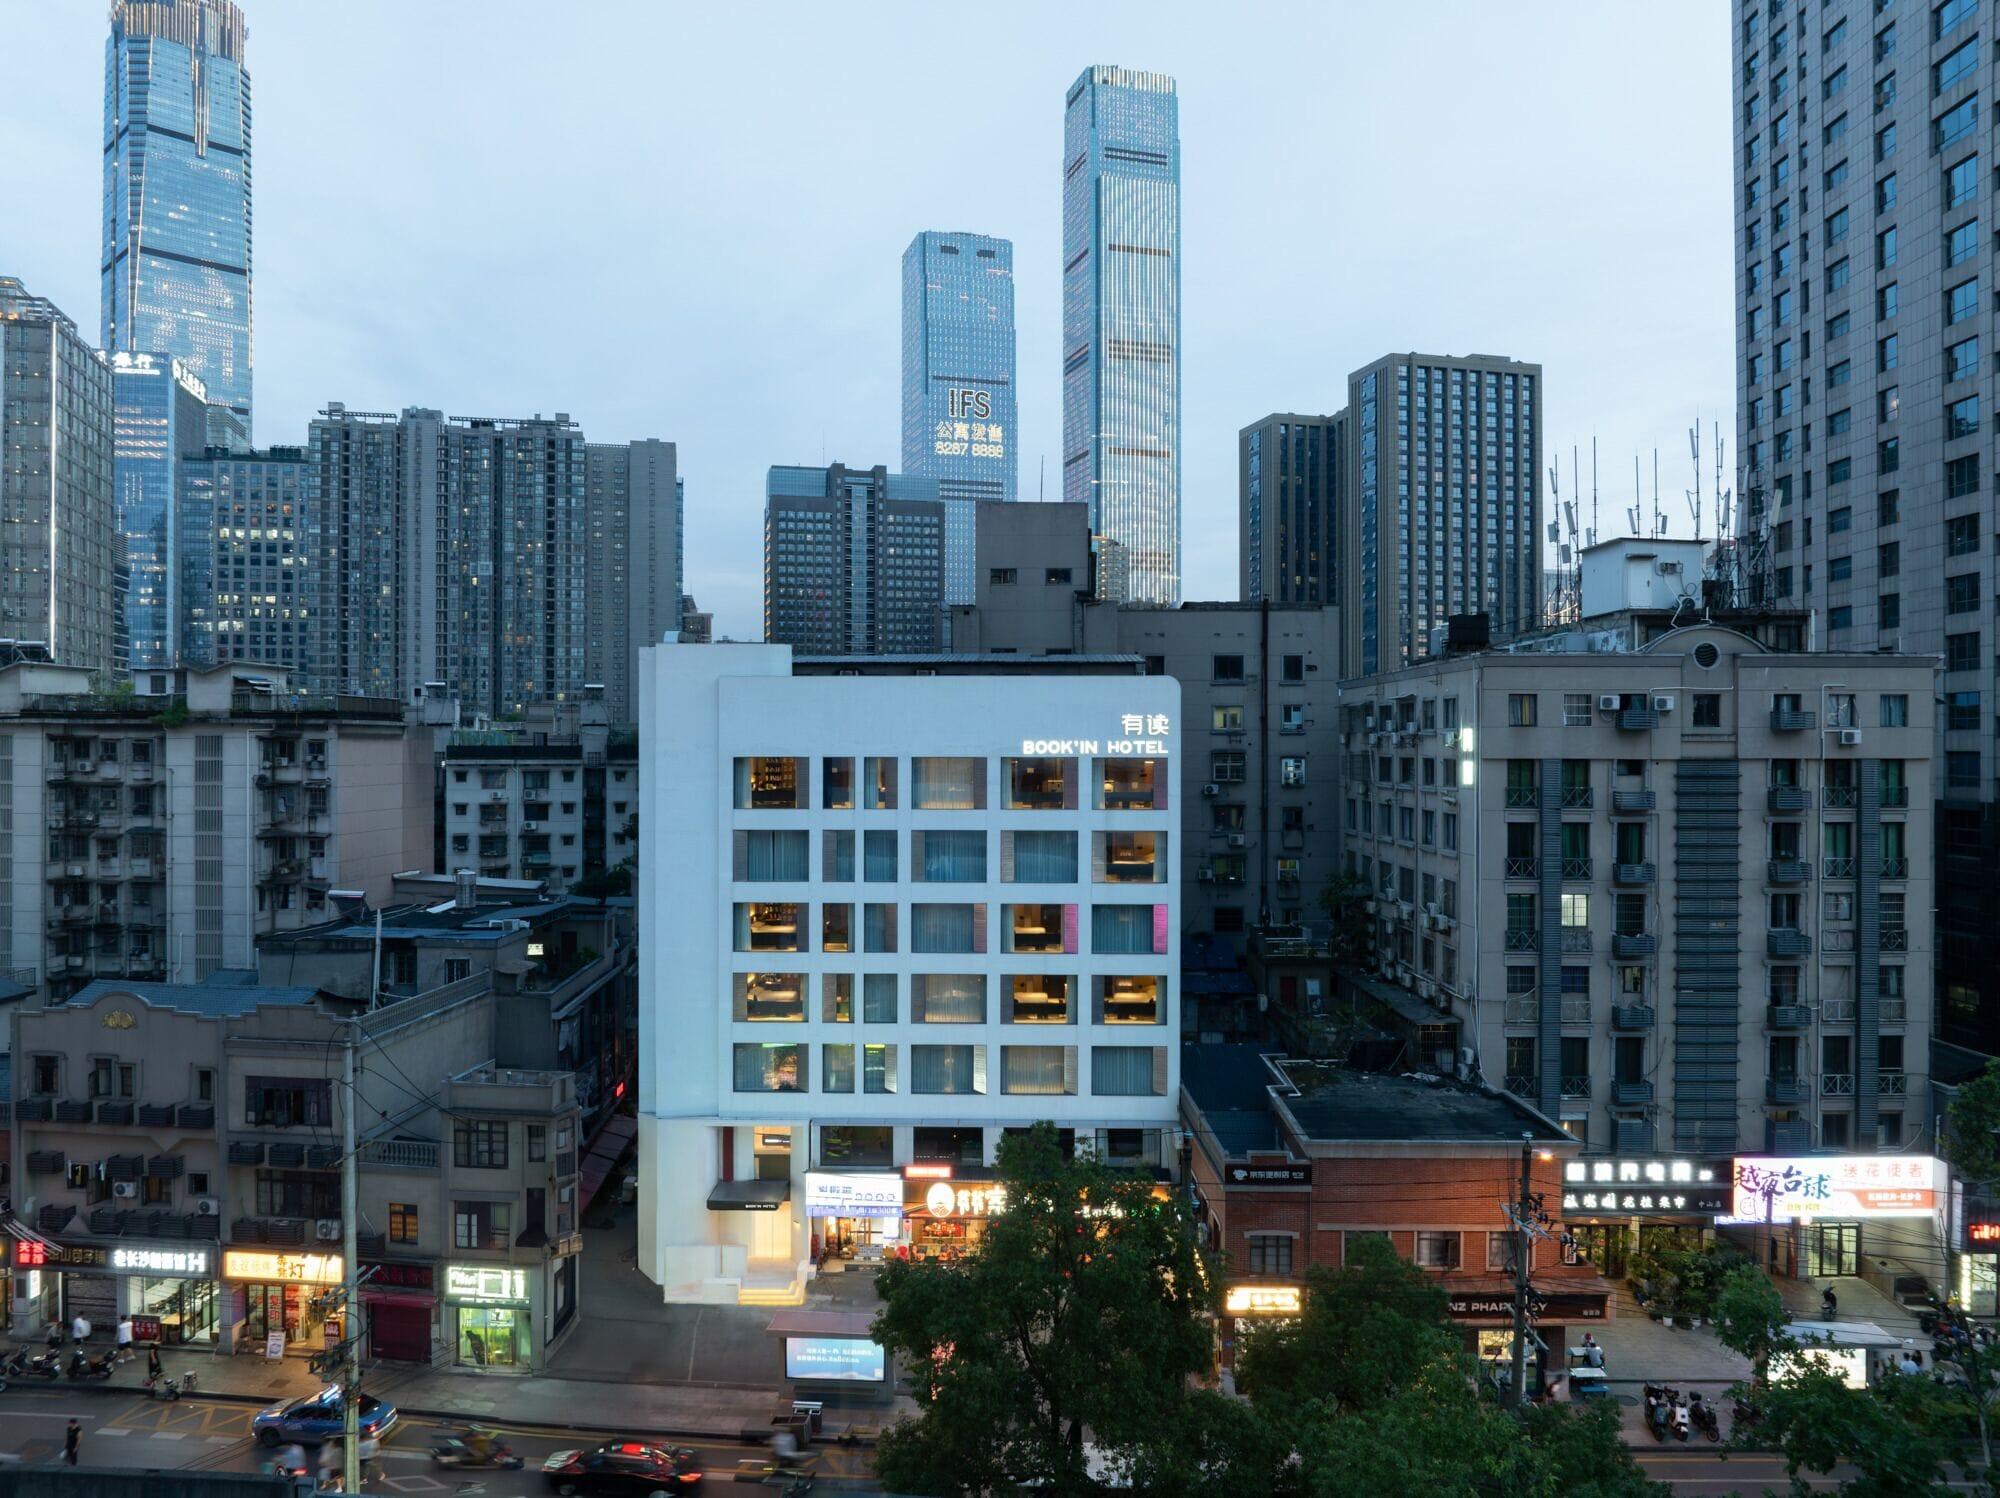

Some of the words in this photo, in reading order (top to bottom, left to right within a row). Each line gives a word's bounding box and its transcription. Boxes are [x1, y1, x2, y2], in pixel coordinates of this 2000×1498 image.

[948, 388, 991, 419] IFS
[1121, 714, 1169, 735] 有读
[1023, 740, 1098, 754] BOOK'IN
[1107, 740, 1169, 754] HOTEL
[1843, 1163, 1924, 1177] 送花使者
[1733, 1165, 1831, 1200] 越夜台球
[1471, 1302, 1548, 1312] PHARCY
